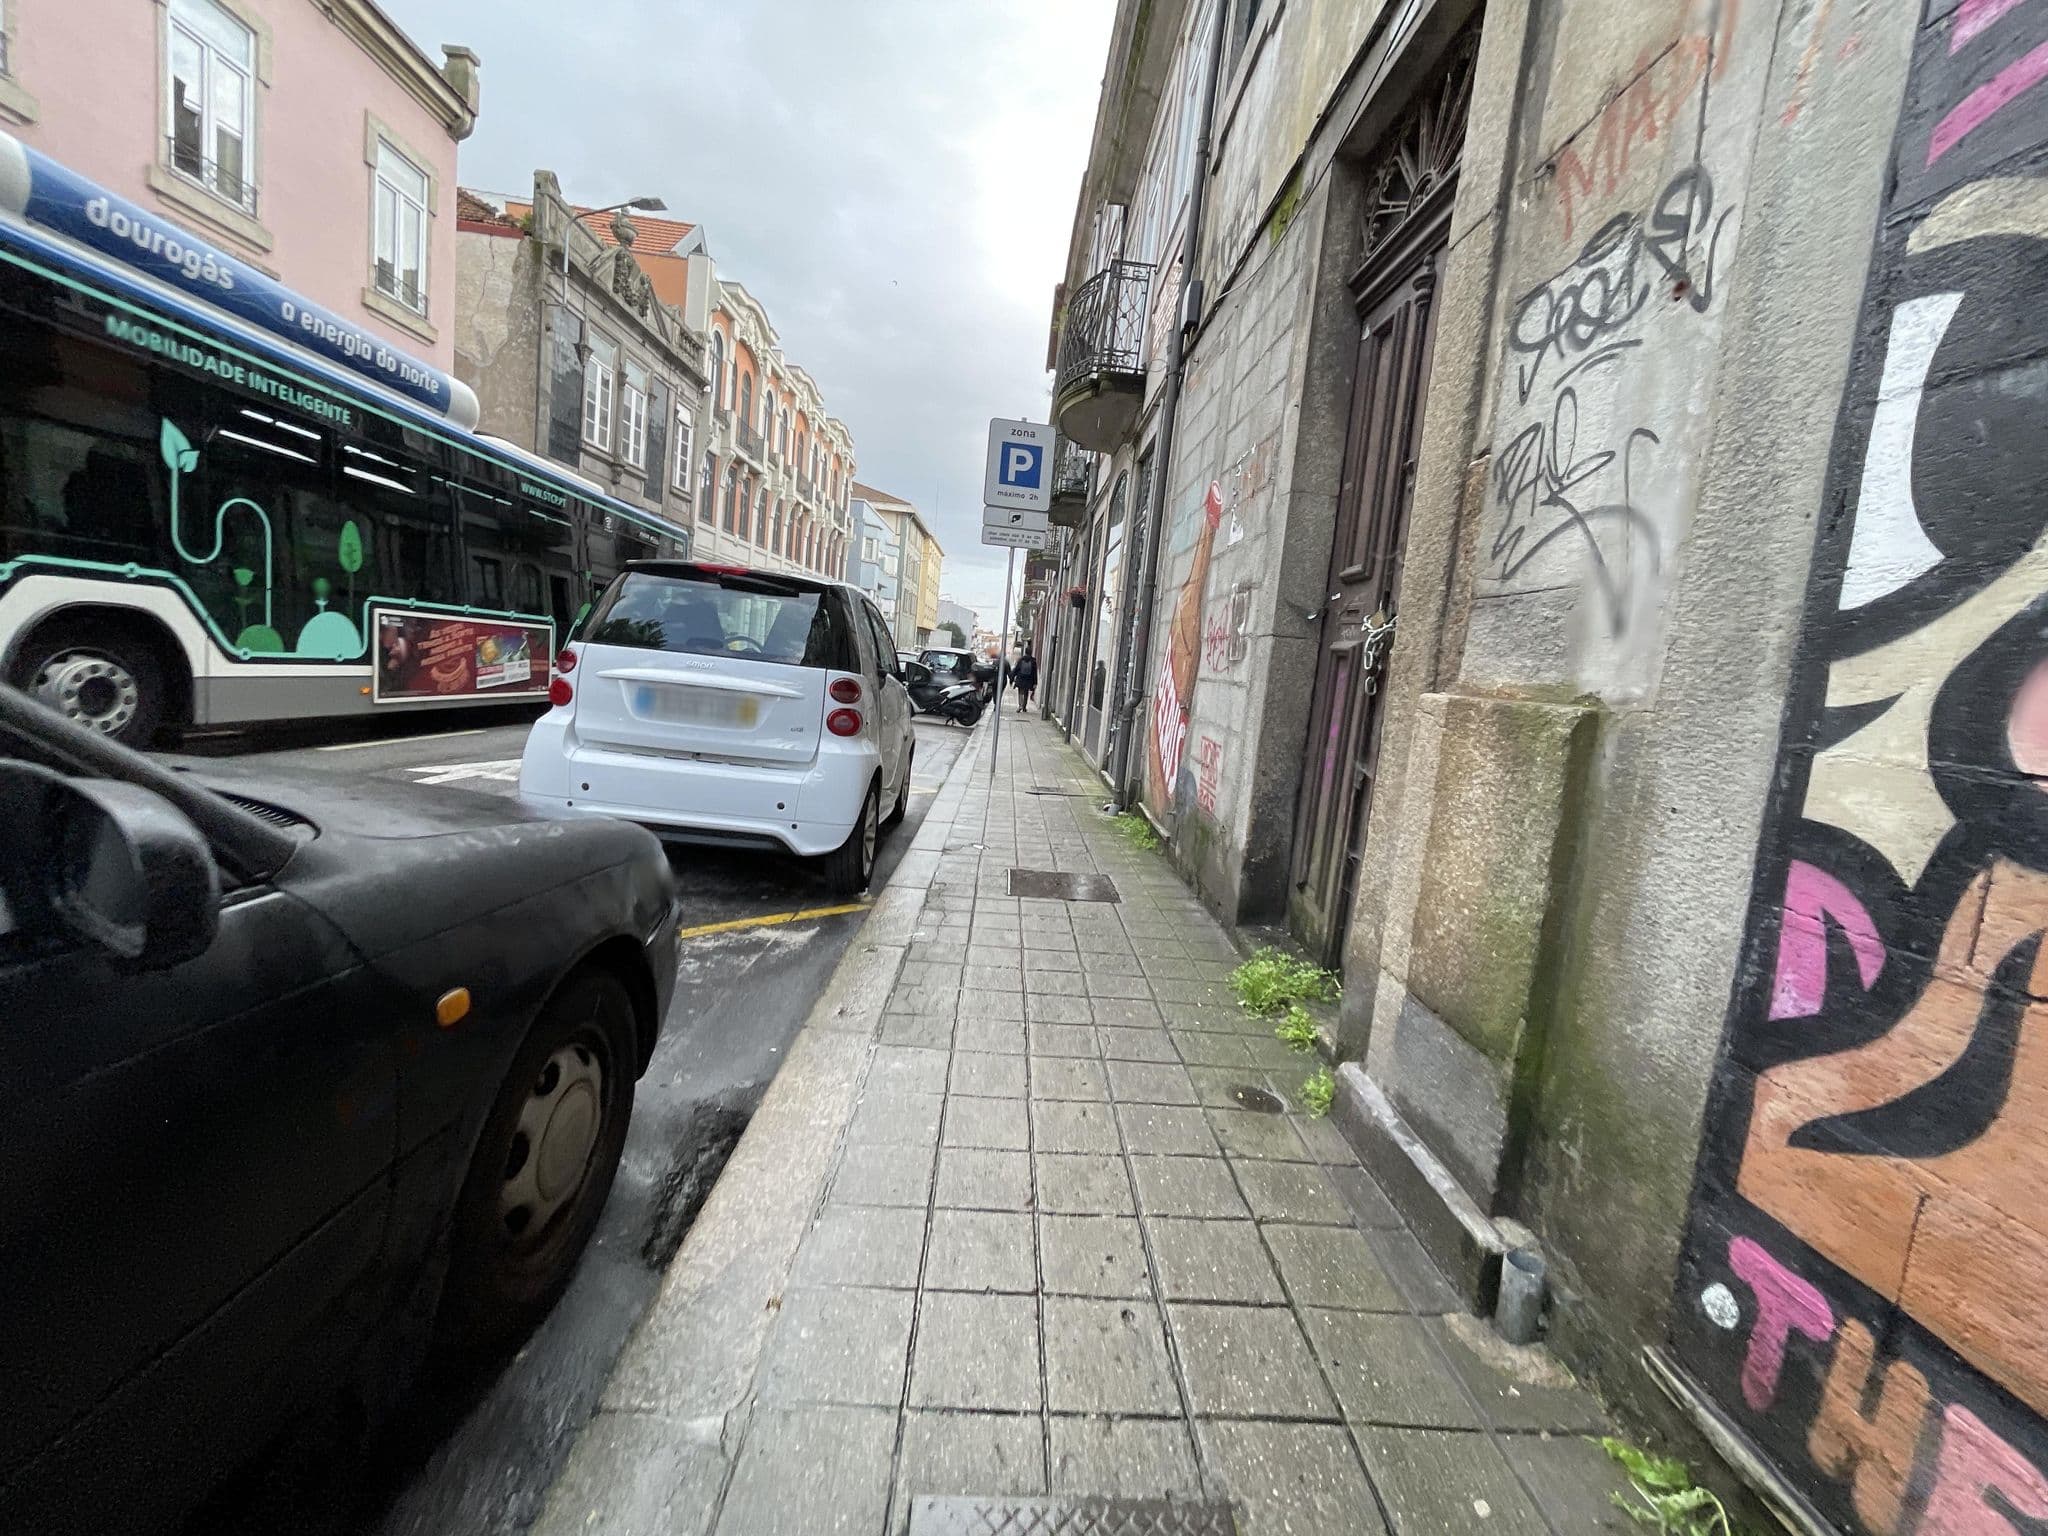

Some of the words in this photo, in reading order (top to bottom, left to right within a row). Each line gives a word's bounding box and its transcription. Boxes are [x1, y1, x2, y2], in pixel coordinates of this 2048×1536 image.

[85, 197, 234, 289] dourogás
[106, 315, 245, 384] MOBILIDADE
[248, 371, 351, 425] INTELIGENTE
[281, 301, 295, 322] a
[300, 312, 372, 361] energia
[376, 348, 397, 372] do
[400, 363, 439, 394] norte
[1007, 447, 1034, 482] P
[1011, 428, 1036, 438] zona
